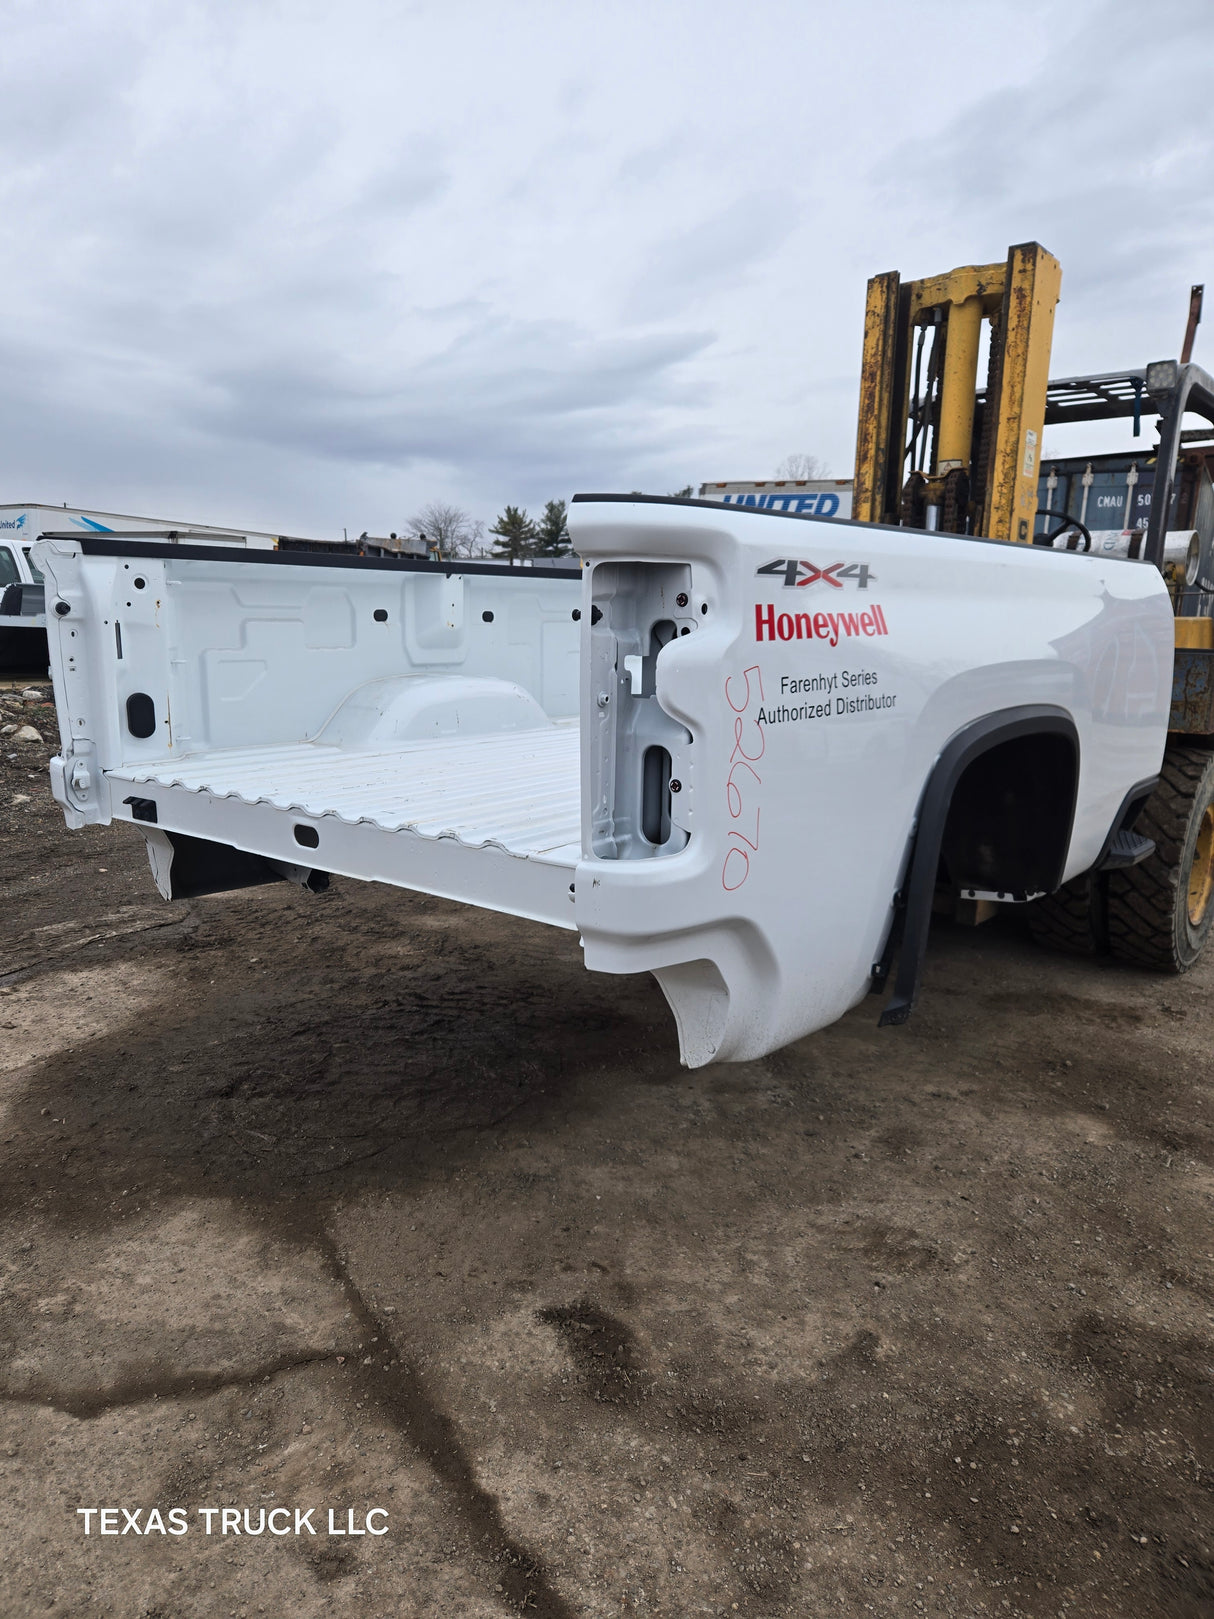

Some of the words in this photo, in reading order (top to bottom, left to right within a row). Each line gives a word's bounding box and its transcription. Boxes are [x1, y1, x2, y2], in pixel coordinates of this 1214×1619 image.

[1097, 496, 1123, 507] CMAU
[755, 604, 888, 647] Honeywell
[781, 674, 838, 695] Farenhyt
[841, 669, 878, 688] Series
[757, 699, 832, 726] Authorized
[836, 694, 897, 715] Distributor
